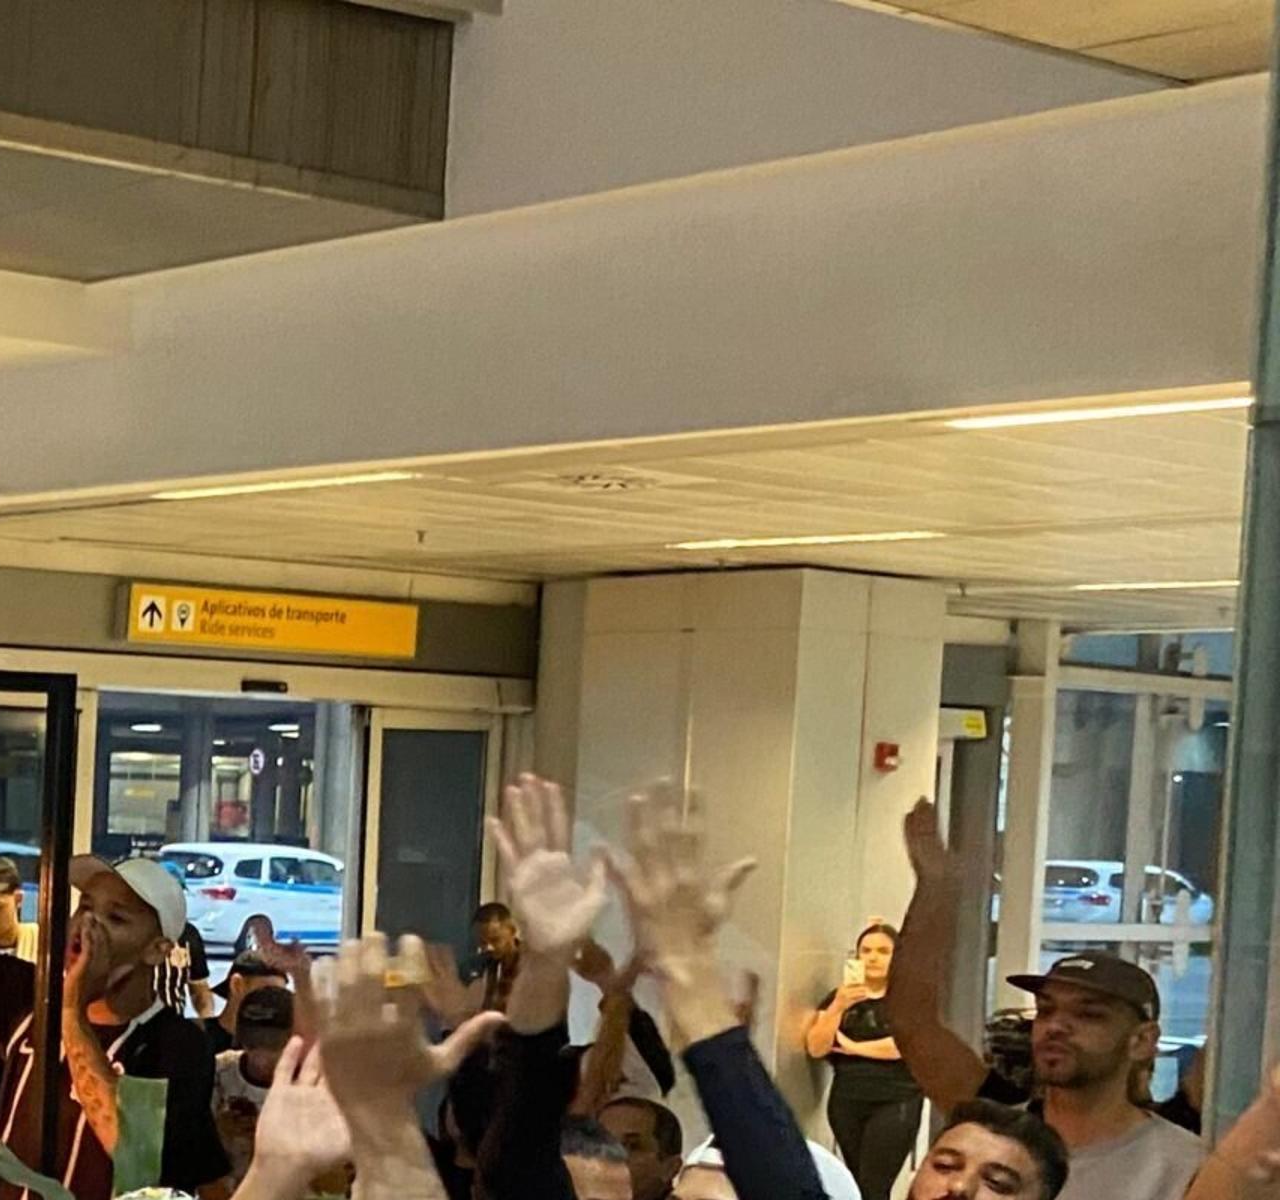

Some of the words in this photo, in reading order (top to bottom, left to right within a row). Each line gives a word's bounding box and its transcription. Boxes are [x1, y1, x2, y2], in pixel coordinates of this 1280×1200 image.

[201, 599, 266, 619] Aplicativos
[269, 604, 282, 620] de
[286, 607, 347, 627] transporte
[200, 619, 225, 635] Ride
[228, 623, 275, 638] services
